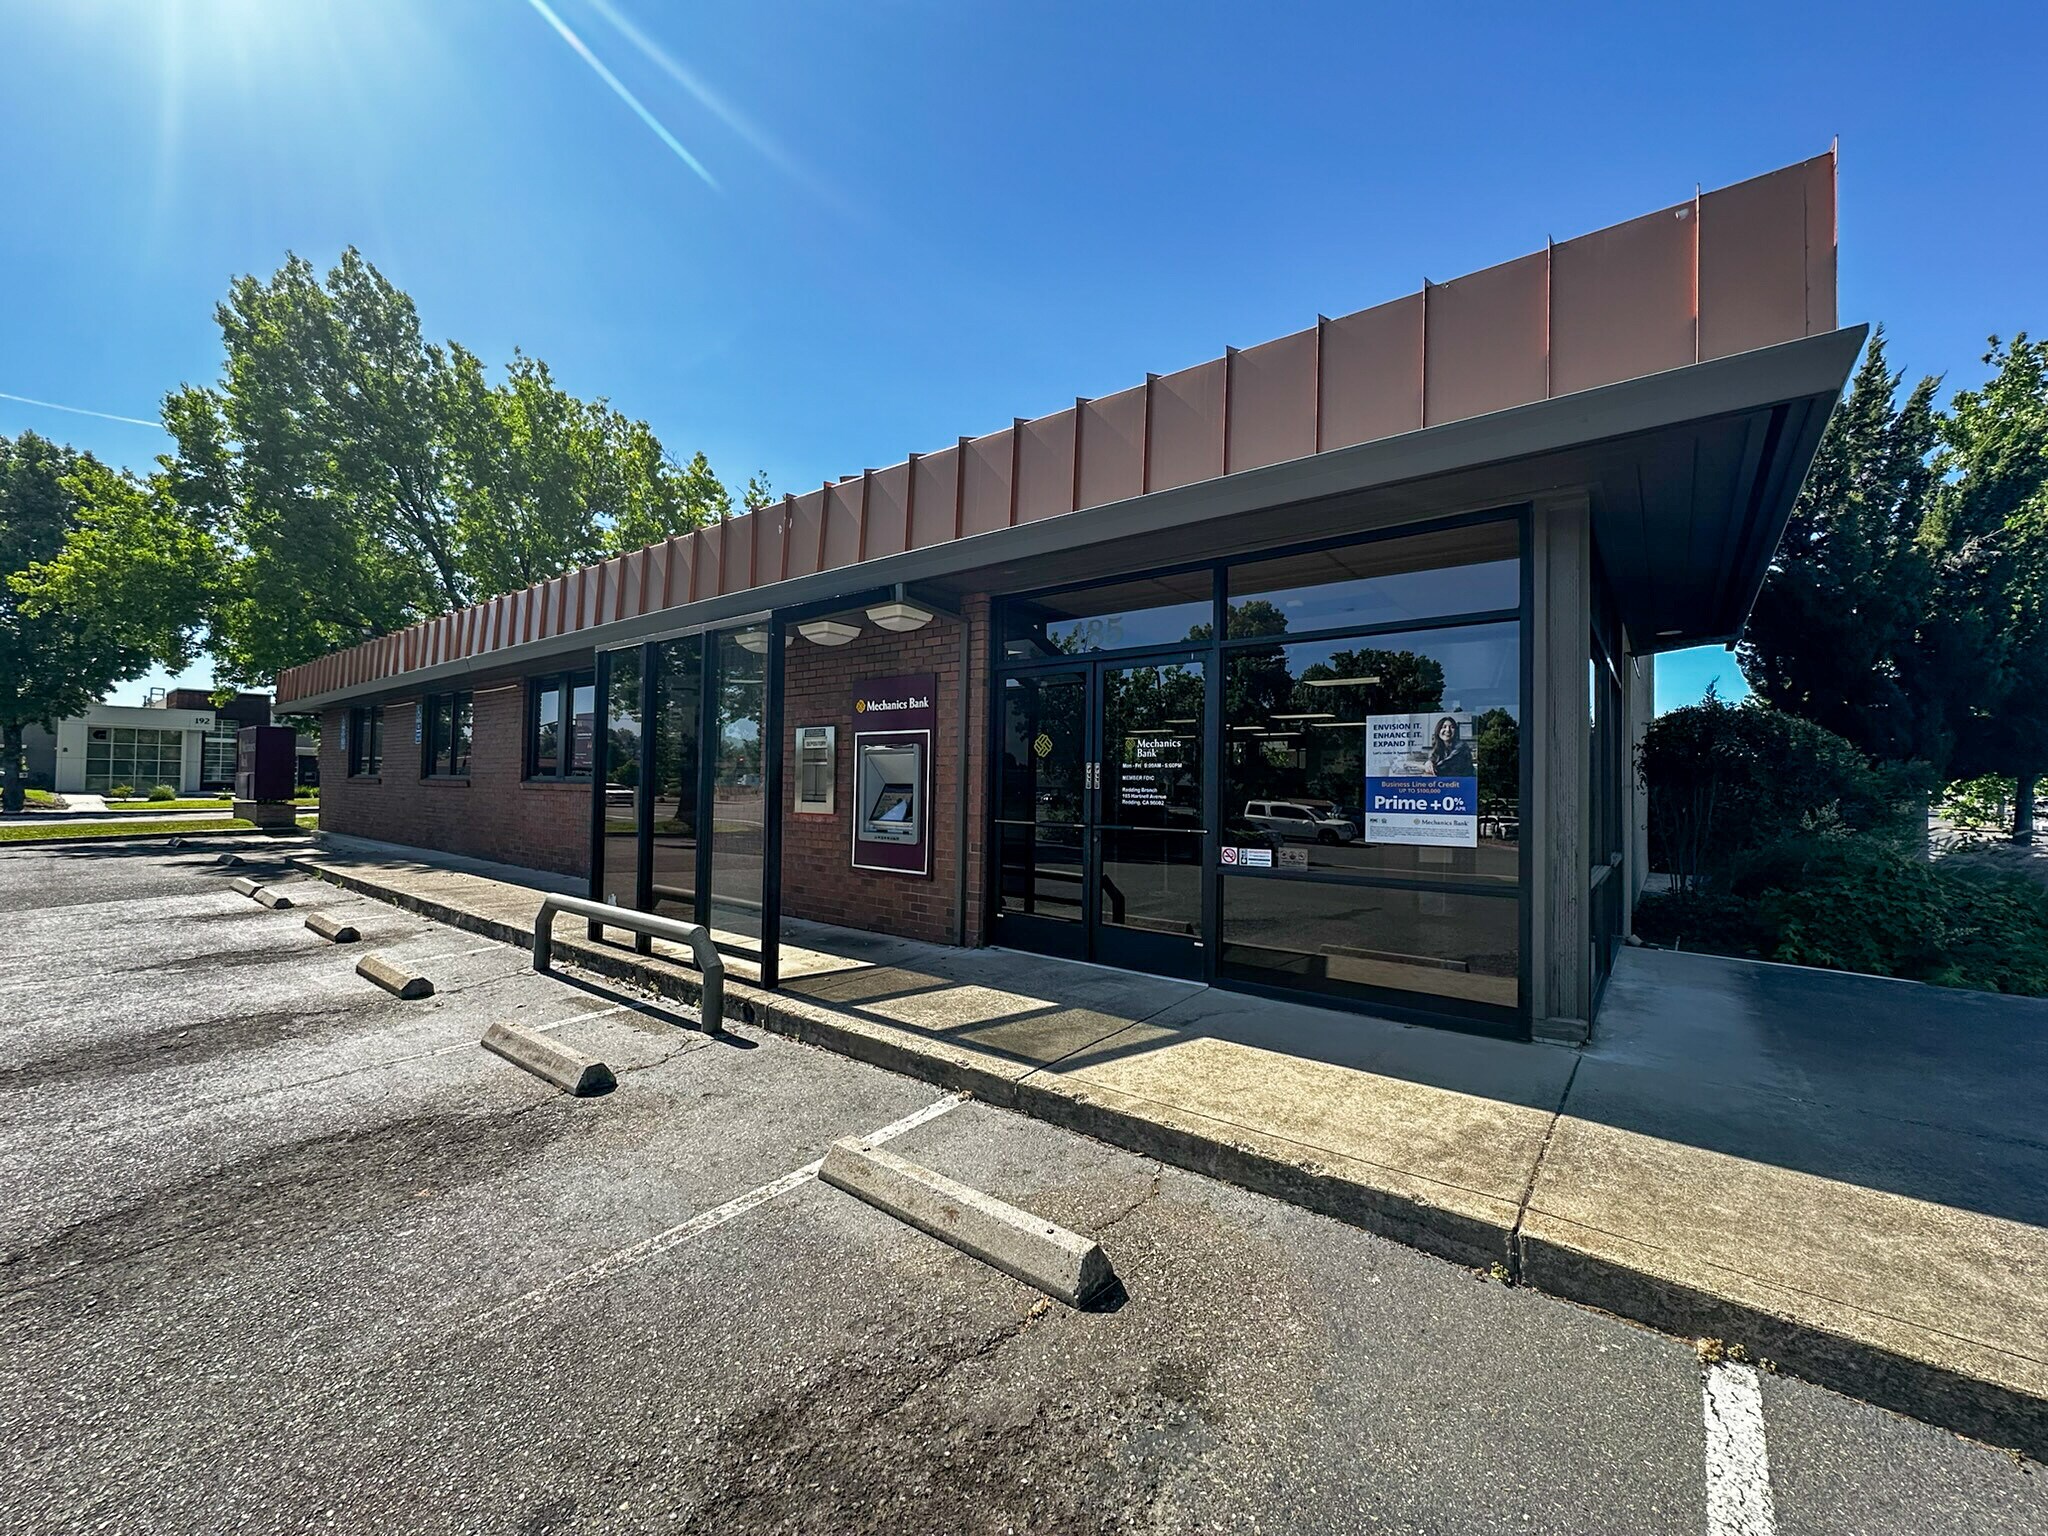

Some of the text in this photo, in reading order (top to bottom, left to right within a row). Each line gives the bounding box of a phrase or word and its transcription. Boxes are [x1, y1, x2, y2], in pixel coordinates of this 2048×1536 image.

[1074, 616, 1123, 649] 185
[867, 697, 929, 711] Mechanics Bank
[1373, 723, 1411, 731] ENVISION
[1137, 739, 1181, 748] Mechanics
[1373, 740, 1406, 748] EXPAND
[1137, 749, 1157, 757] Bank
[1374, 795, 1428, 810] Prime
